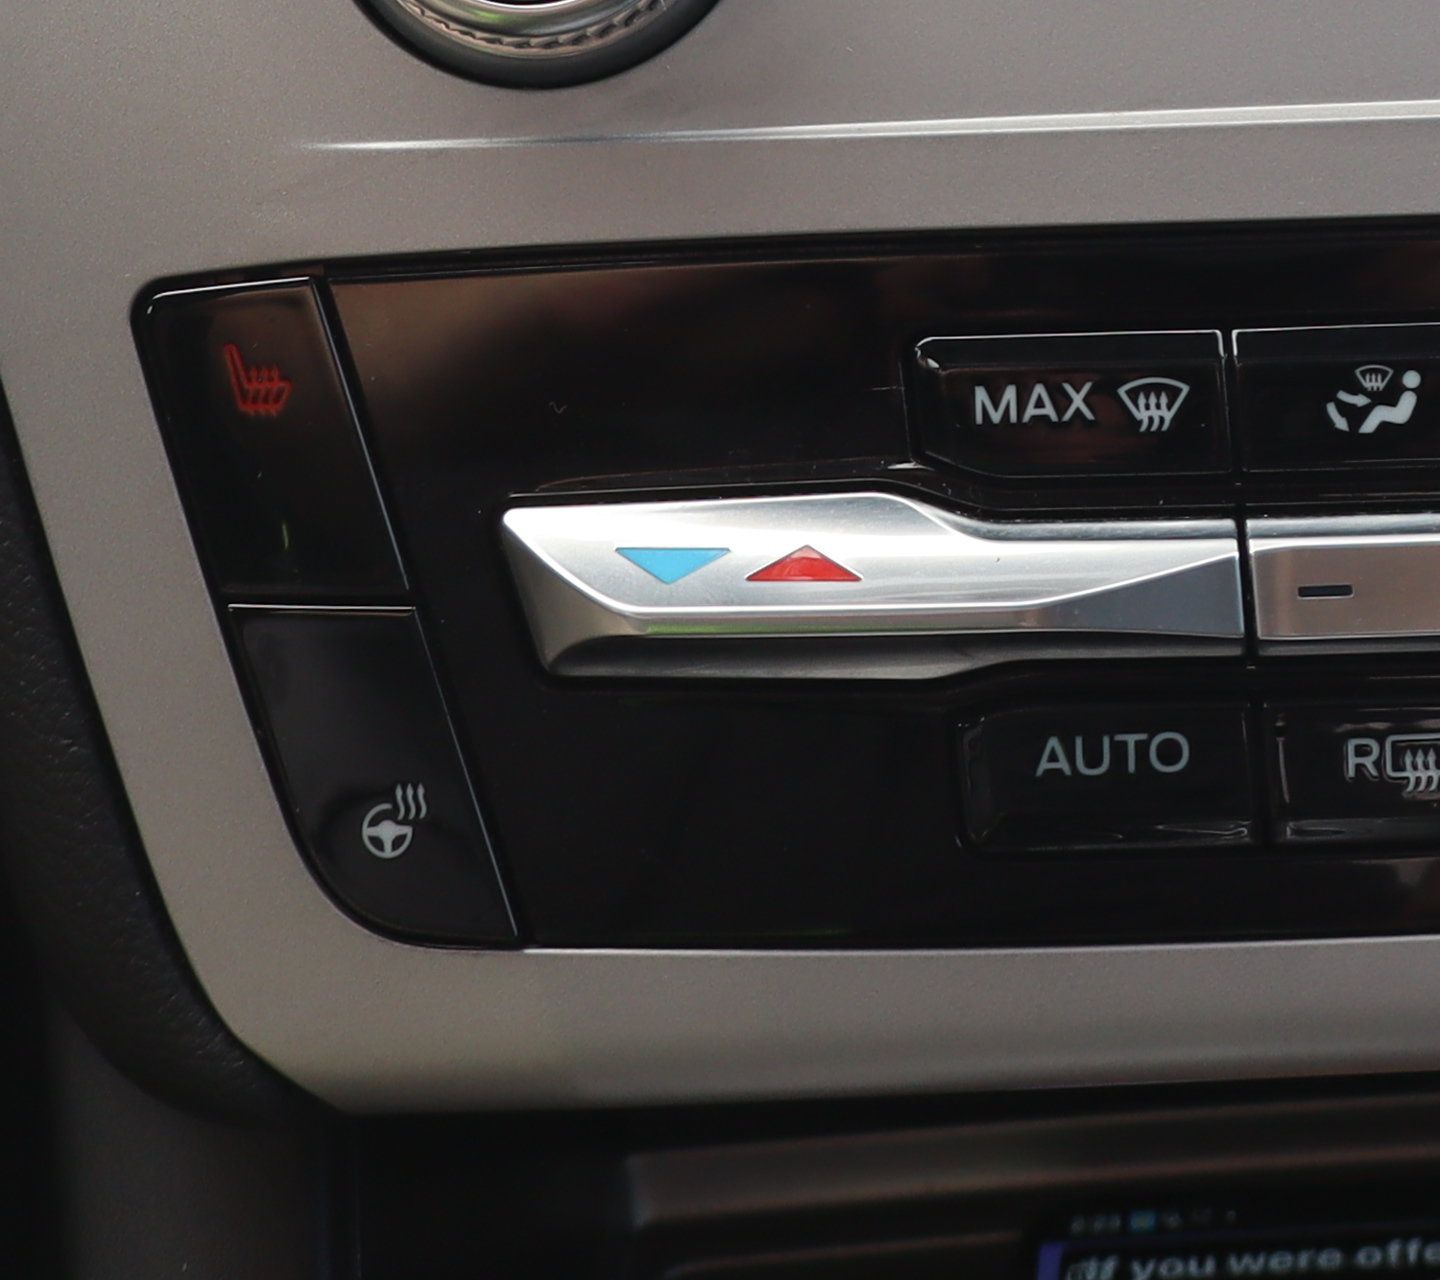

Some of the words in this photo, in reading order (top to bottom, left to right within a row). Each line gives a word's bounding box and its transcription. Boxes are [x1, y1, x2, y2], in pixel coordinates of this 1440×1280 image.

[973, 381, 1096, 426] MAX
[1035, 732, 1191, 777] AUTO
[1127, 1253, 1217, 1280] you
[1226, 1245, 1346, 1273] were
